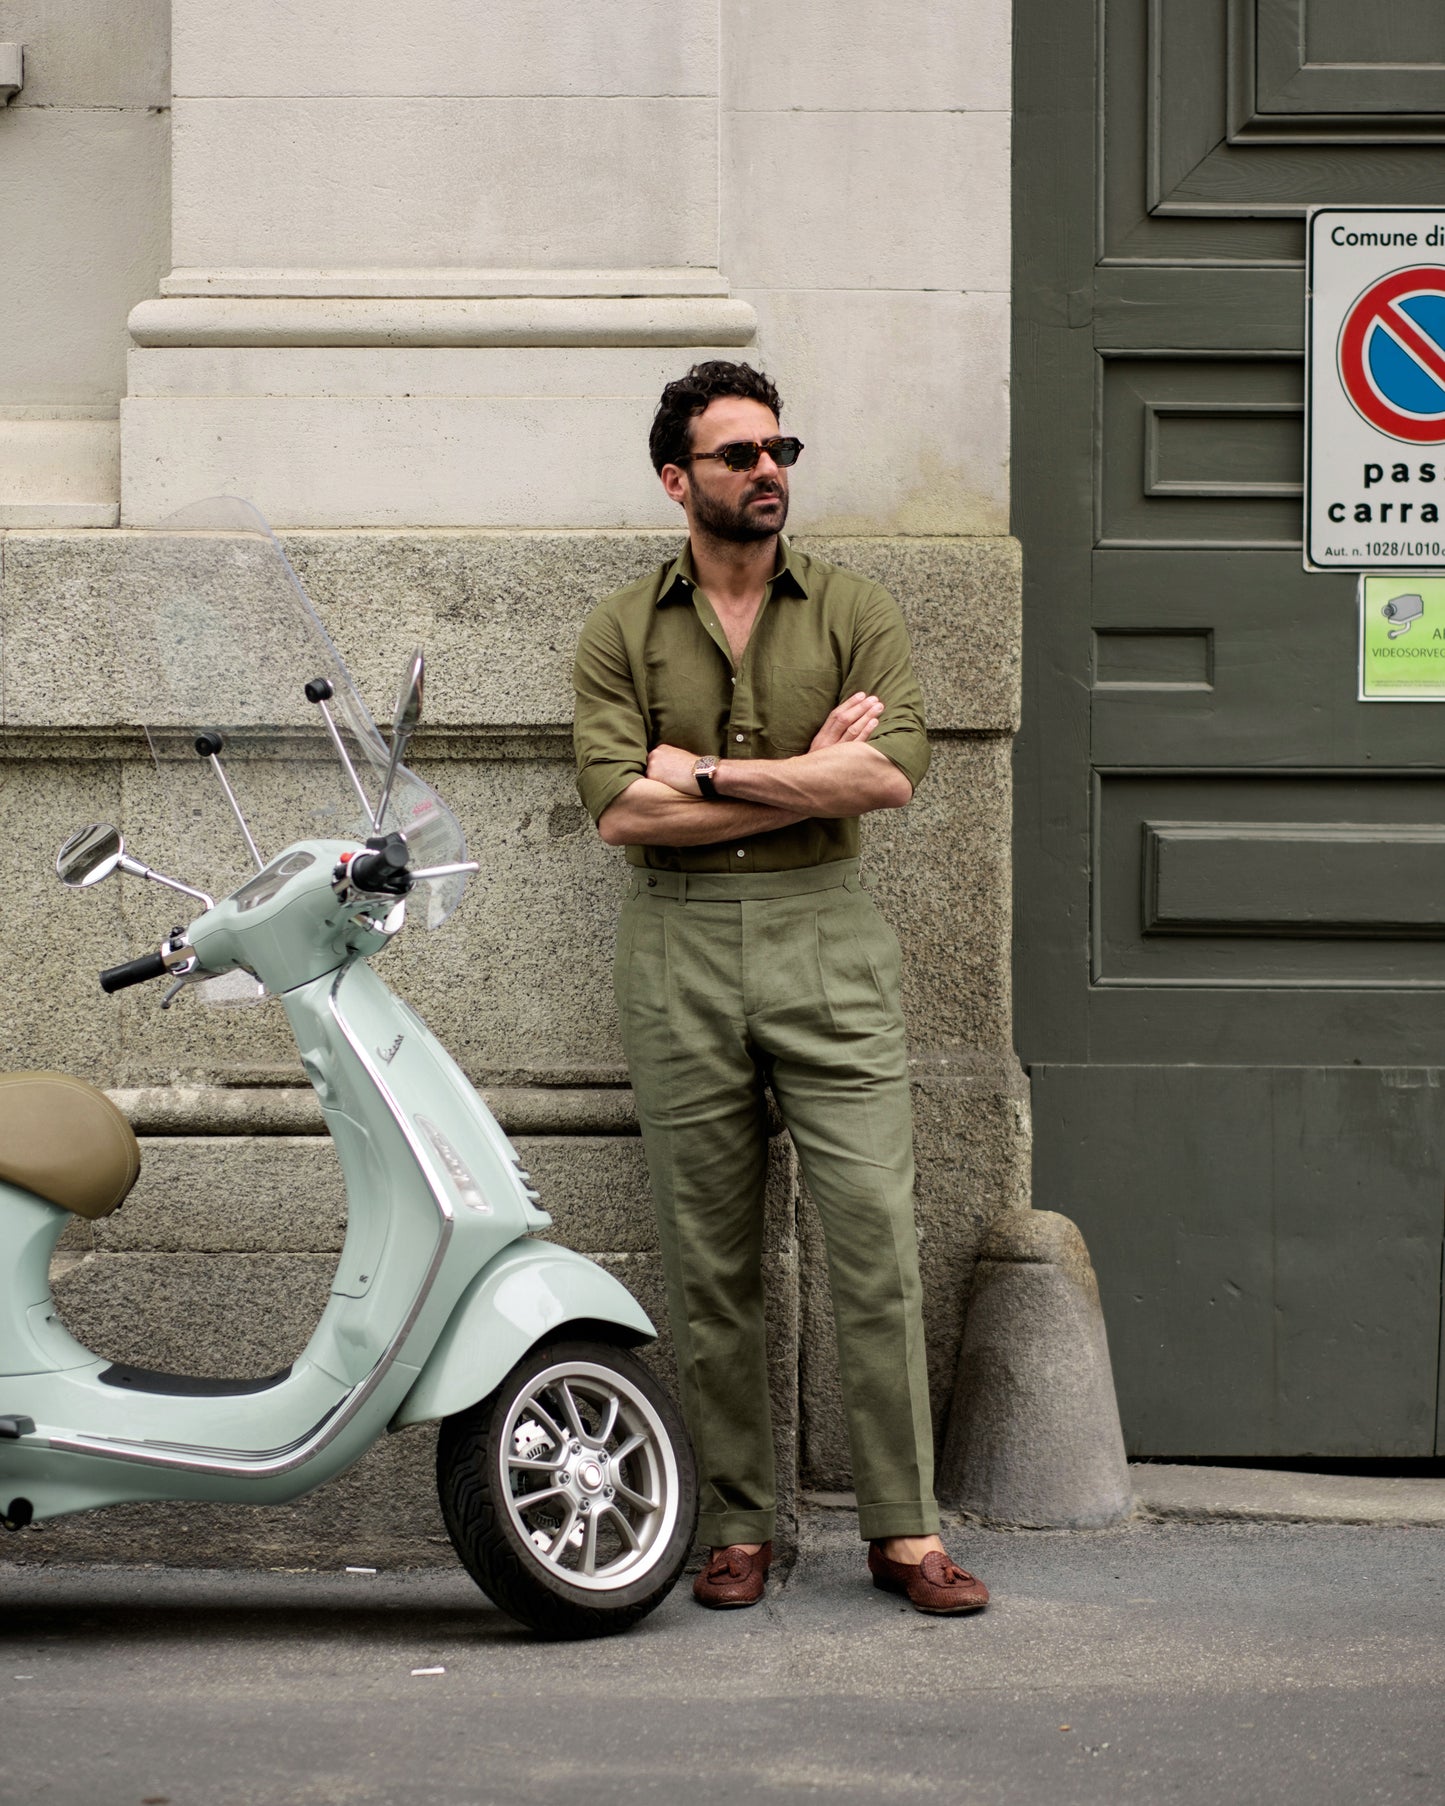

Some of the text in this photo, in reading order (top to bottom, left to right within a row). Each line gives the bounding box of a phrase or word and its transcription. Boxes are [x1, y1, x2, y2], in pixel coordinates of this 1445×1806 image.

[1331, 224, 1445, 247] Comune di
[1364, 463, 1445, 489] pas
[1327, 502, 1440, 523] carra
[1325, 547, 1348, 556] Aut.
[1432, 627, 1445, 640] A
